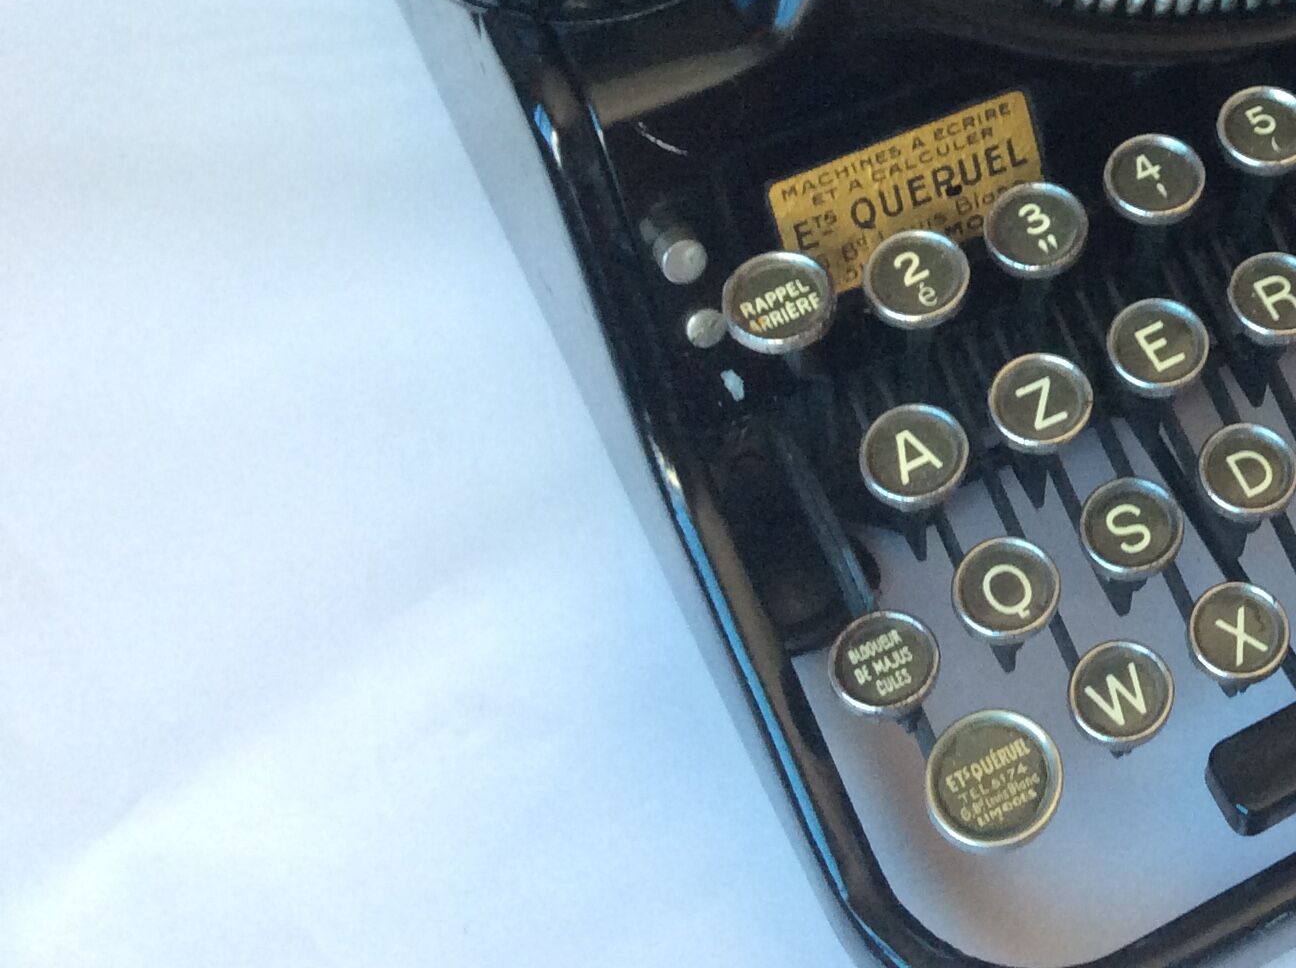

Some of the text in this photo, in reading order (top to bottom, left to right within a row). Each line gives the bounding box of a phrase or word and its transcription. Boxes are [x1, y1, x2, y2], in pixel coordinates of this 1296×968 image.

[1245, 105, 1276, 135] 5
[781, 102, 1012, 202] MACHINES A ECRIRE
[811, 127, 994, 206] ET A CALCULER
[1136, 154, 1161, 180] 4
[850, 137, 1028, 230] QUERUEL
[1018, 203, 1051, 235] 3
[893, 251, 930, 287] 2
[740, 279, 810, 318] RAPPEL
[1134, 320, 1186, 373] E
[1015, 376, 1068, 431] Z
[895, 429, 943, 485] A
[1226, 450, 1273, 498] D
[1105, 504, 1151, 554] S
[982, 564, 1033, 619] Q
[1215, 606, 1268, 666] X
[853, 646, 913, 685] DE MAJUS
[876, 669, 912, 697] CULES
[1084, 662, 1147, 726] W
